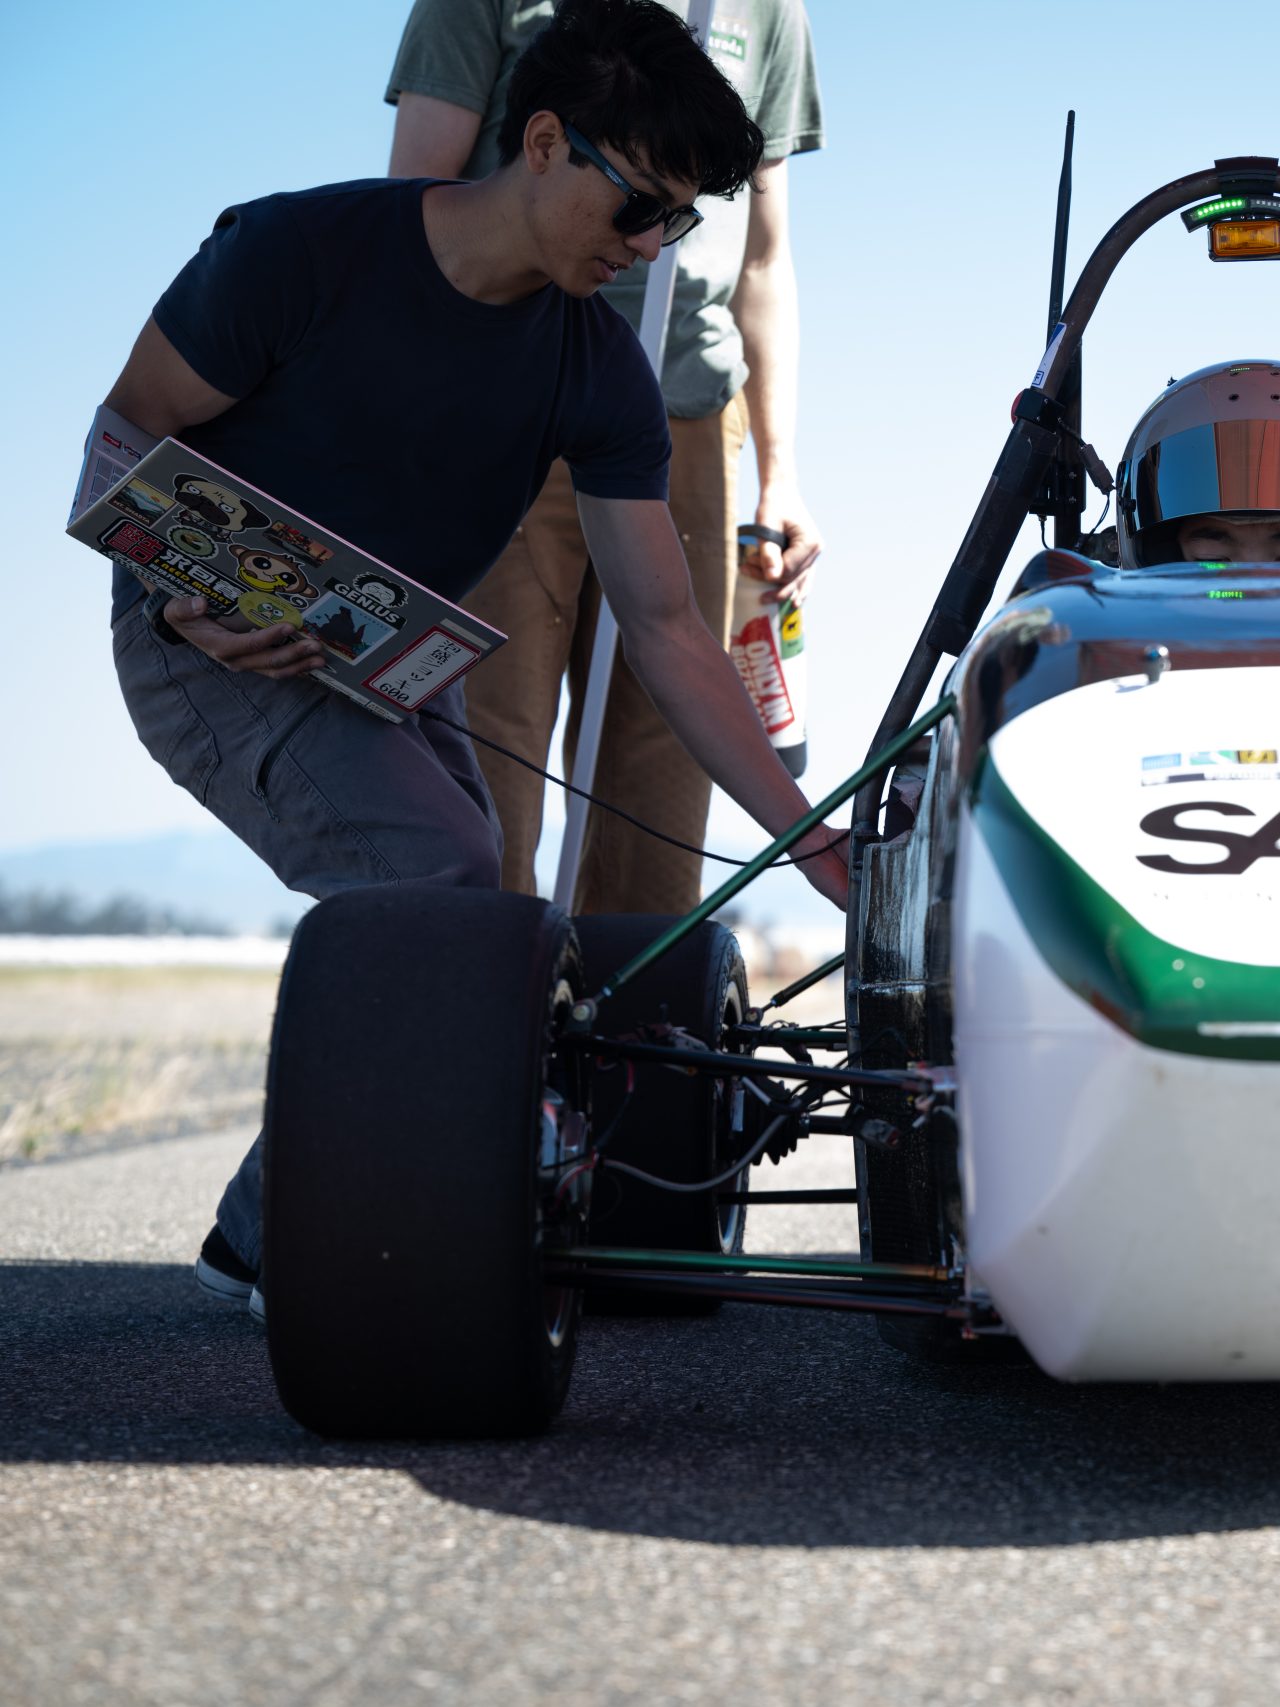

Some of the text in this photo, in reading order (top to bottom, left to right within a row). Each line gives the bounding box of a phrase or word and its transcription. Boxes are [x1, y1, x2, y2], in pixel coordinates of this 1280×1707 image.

[380, 683, 410, 702] 600
[745, 640, 793, 726] ONLY IN
